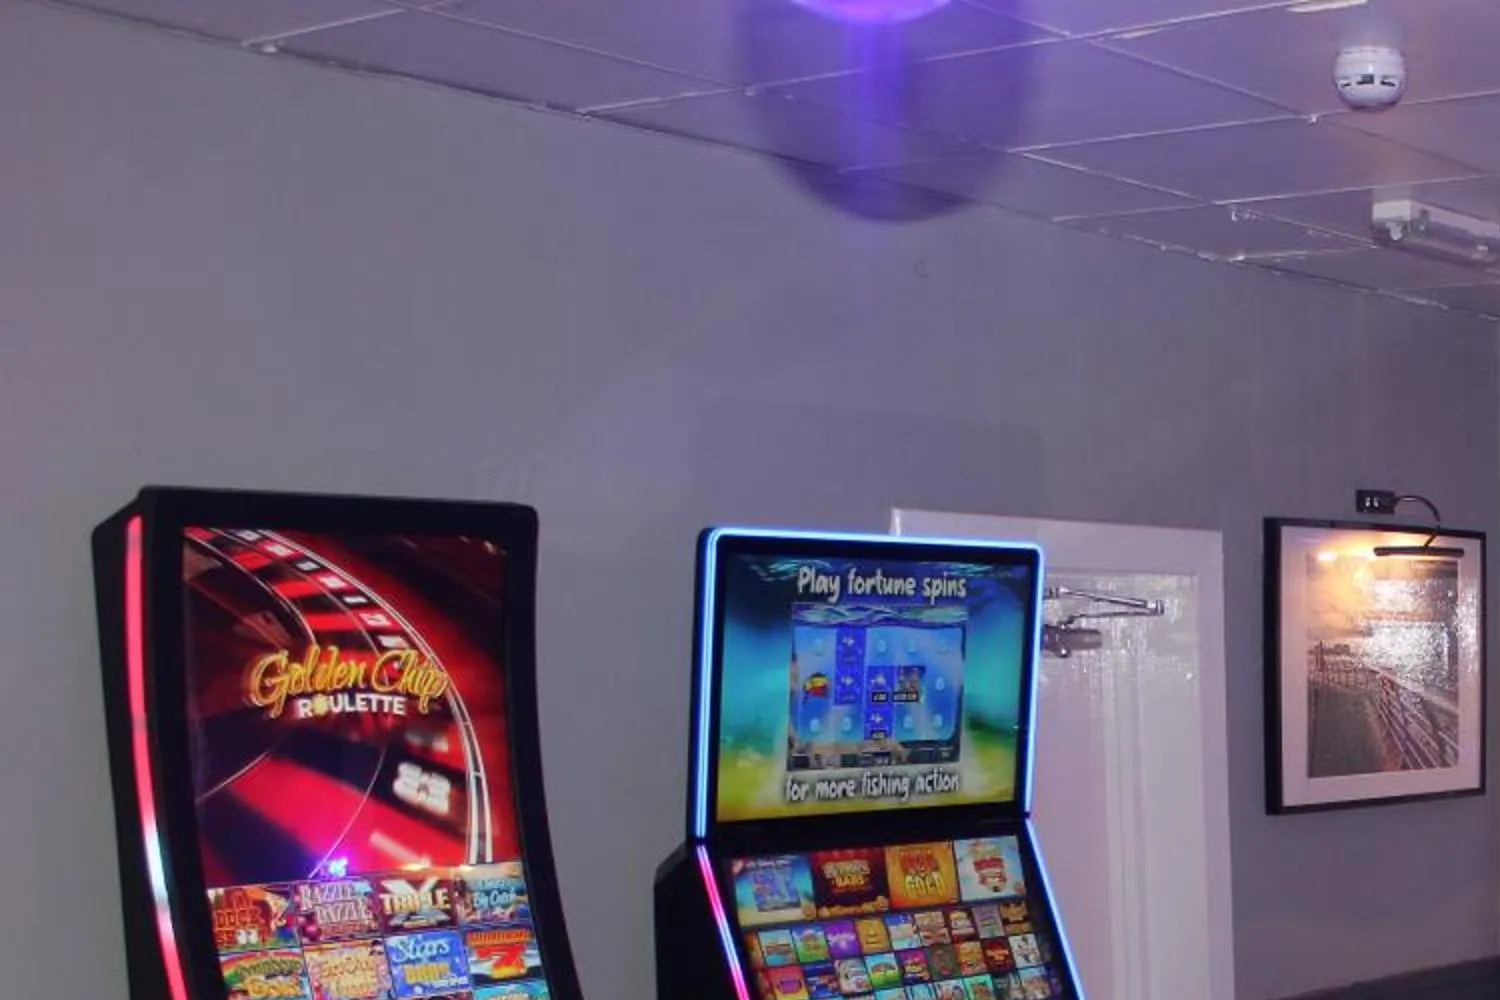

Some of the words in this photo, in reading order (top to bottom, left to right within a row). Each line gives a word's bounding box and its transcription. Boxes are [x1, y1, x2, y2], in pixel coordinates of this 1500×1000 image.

[799, 565, 841, 603] Play
[848, 567, 917, 597] fortune
[922, 571, 968, 606] spins
[249, 643, 367, 719] Golden
[371, 649, 449, 715] Chip
[298, 692, 408, 719] ROULETTE
[786, 775, 811, 801] for
[815, 778, 856, 800] more
[861, 771, 911, 802] fishing
[915, 767, 961, 794] action
